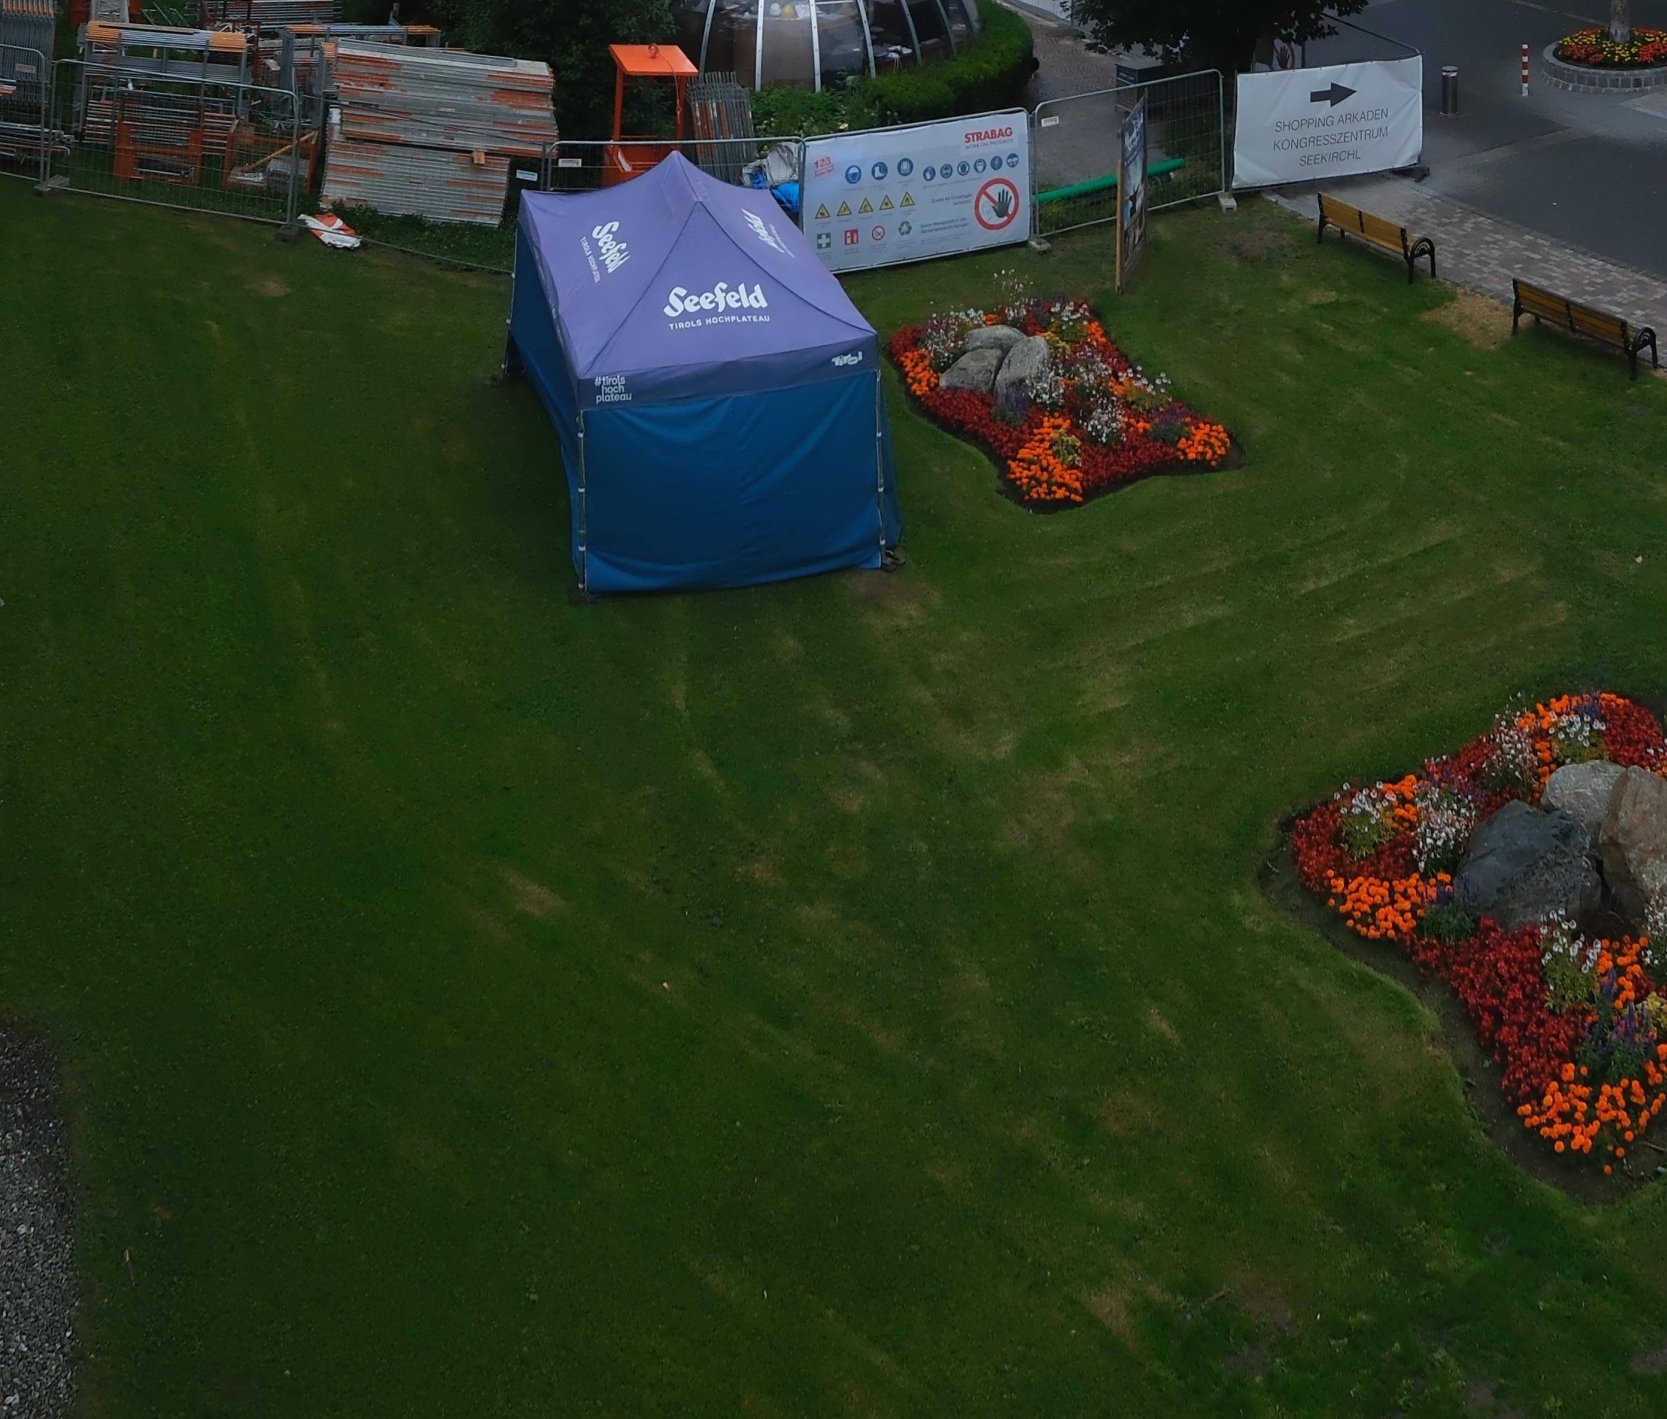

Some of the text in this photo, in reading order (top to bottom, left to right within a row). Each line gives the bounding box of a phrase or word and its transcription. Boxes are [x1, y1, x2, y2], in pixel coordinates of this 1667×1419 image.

[1275, 107, 1389, 133] SHOPPING ARKADEN
[964, 127, 1013, 144] STRABAG
[1273, 127, 1388, 151] KONGRESSZENTRUM
[1299, 149, 1361, 167] SEEKIRCHL
[592, 221, 630, 274] Seefeld
[663, 281, 768, 317] Seefeld
[669, 315, 770, 330] TIROLS HOCHPLATEAU
[594, 376, 626, 386] #tirols
[601, 384, 625, 393] hoch
[595, 392, 632, 405] plateau
